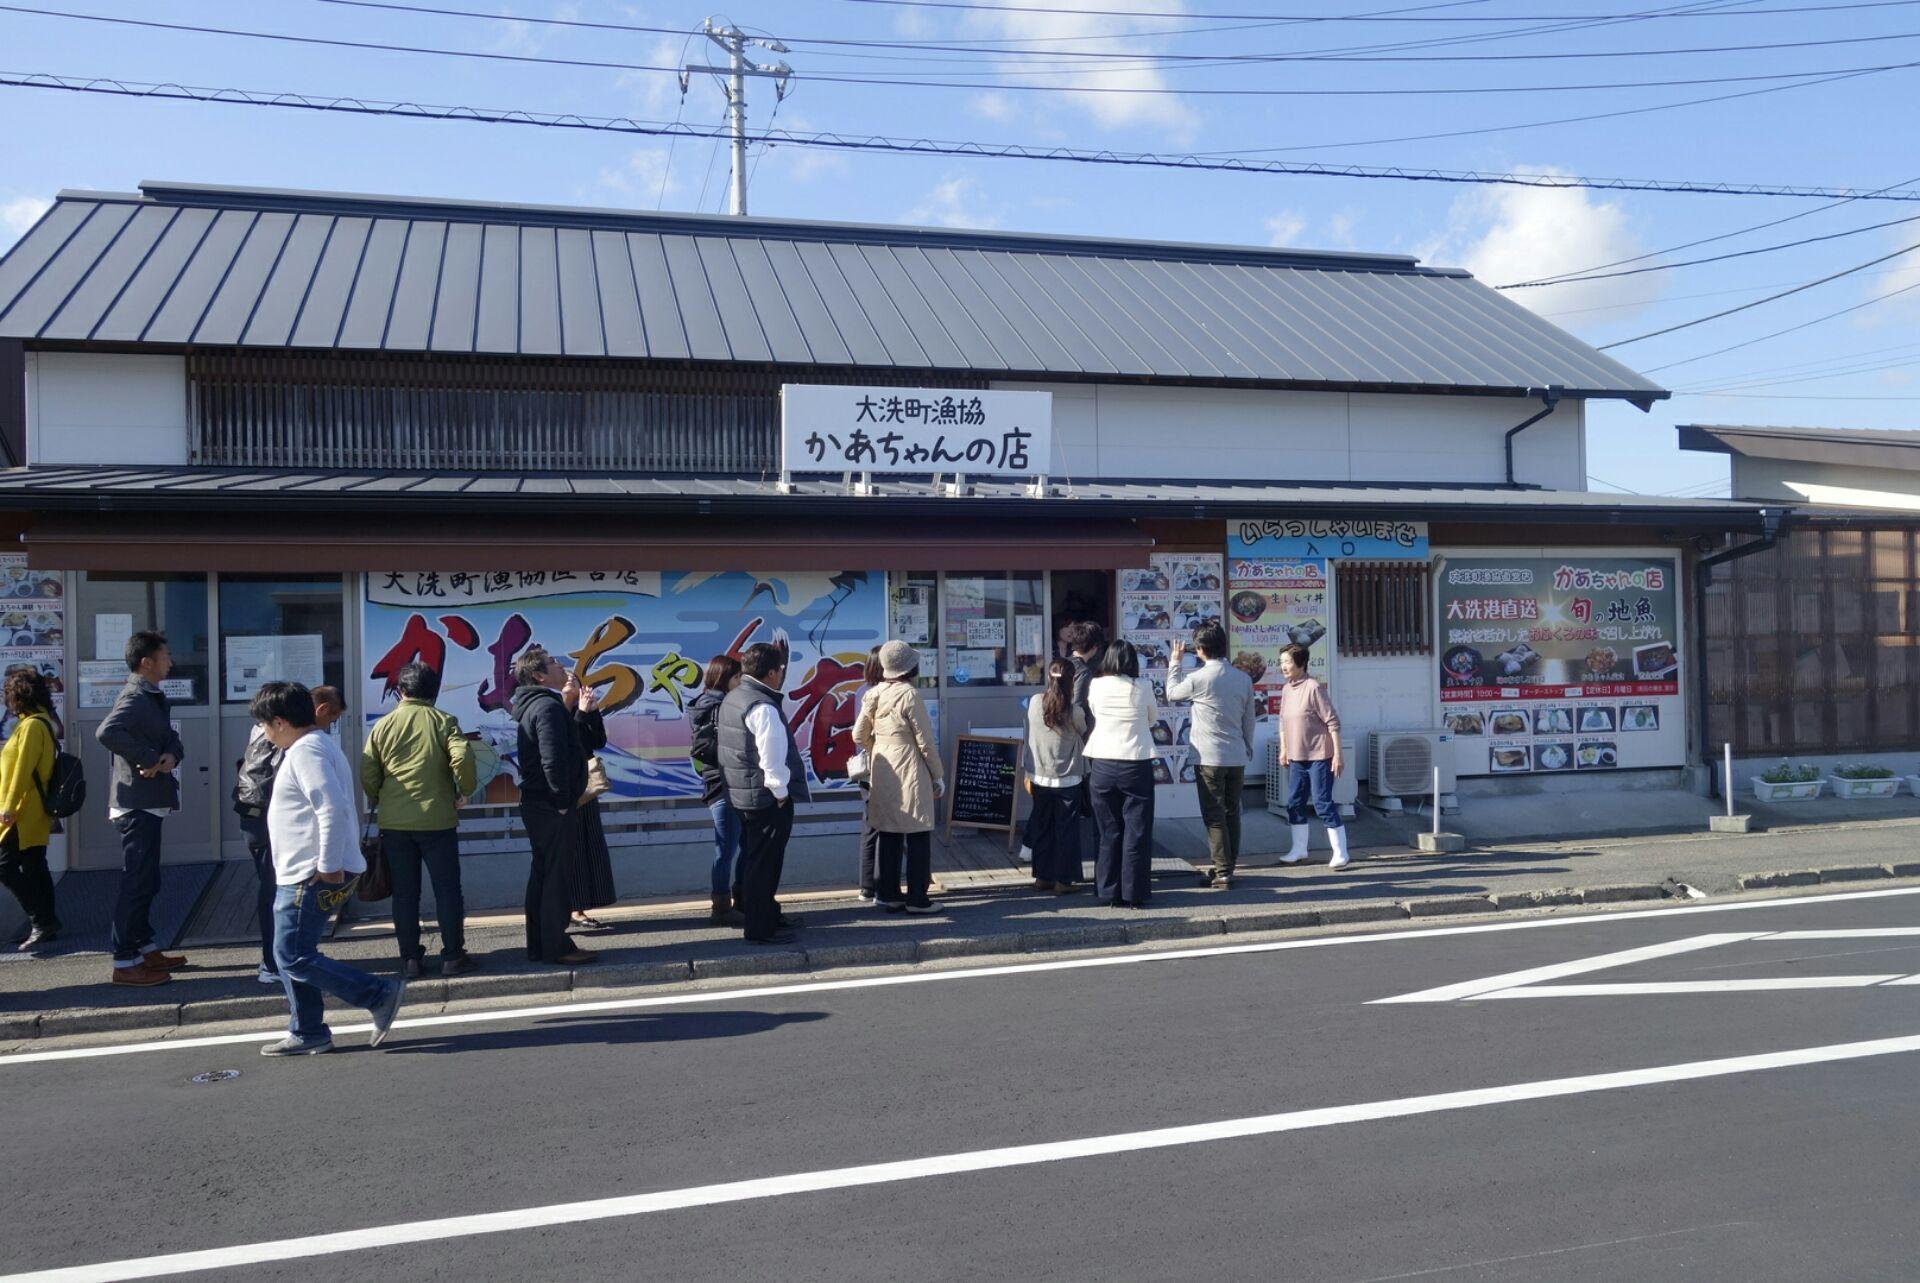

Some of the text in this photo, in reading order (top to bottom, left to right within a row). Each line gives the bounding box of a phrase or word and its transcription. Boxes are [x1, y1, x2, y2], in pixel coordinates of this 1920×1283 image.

[856, 394, 986, 425] 大洗町漁協
[804, 426, 1033, 470] かあちゃんの店
[1239, 520, 1417, 548] いらっしゃいませ
[1237, 562, 1319, 578] かあちゃんの店
[1553, 565, 1664, 591] かあちゃんの店
[1446, 596, 1656, 625] 大洗港直送 旬の地魚
